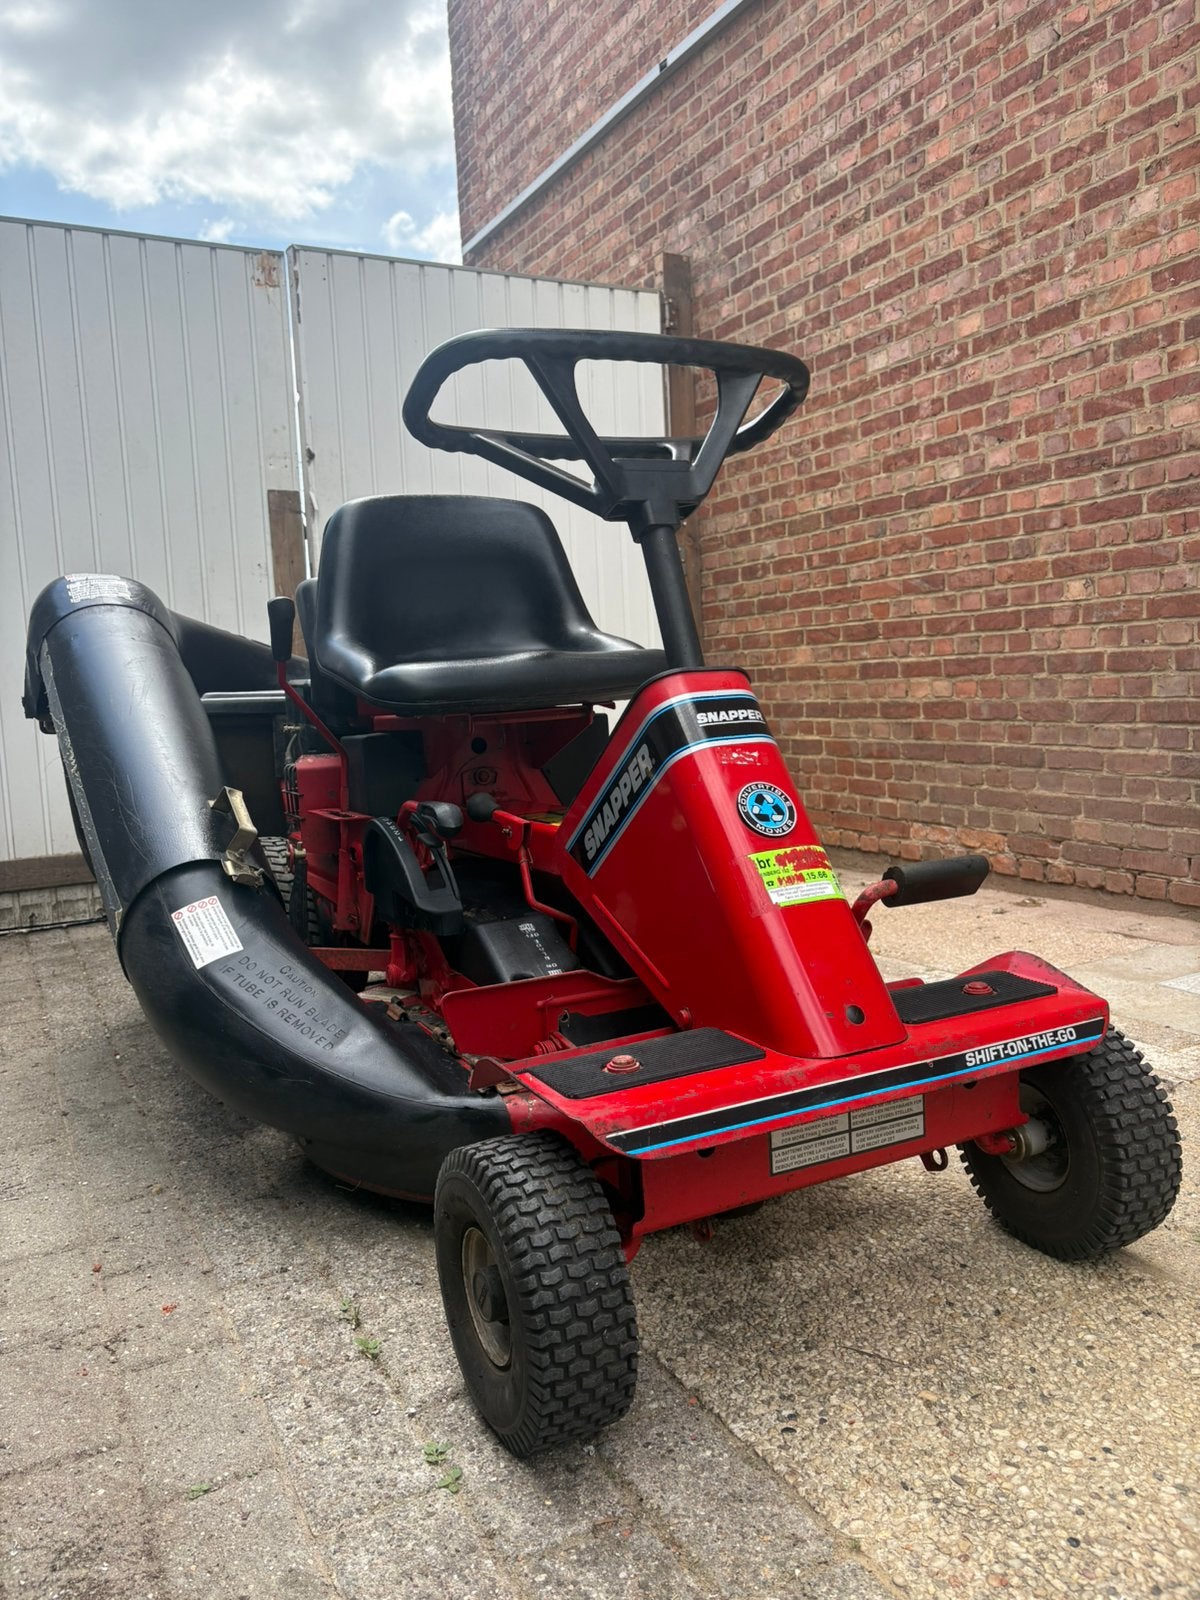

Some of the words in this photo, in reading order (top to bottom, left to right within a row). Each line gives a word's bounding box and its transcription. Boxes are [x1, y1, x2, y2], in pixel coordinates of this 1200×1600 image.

[697, 709, 764, 723] SNAPPER
[584, 744, 653, 860] SNAPPER
[741, 783, 791, 812] CONVERTIBLE
[756, 820, 792, 834] MOWER
[238, 956, 258, 970] DO
[256, 970, 283, 988] NOT
[280, 988, 307, 1008] RUN
[304, 1007, 346, 1038] BLADE
[280, 965, 318, 998] CAUTION
[219, 964, 235, 974] IF
[232, 973, 265, 999] TUBE
[264, 997, 279, 1010] IS
[276, 1008, 335, 1051] REMOVED
[965, 1027, 1077, 1067] SHIFT-ON-THE-GO
